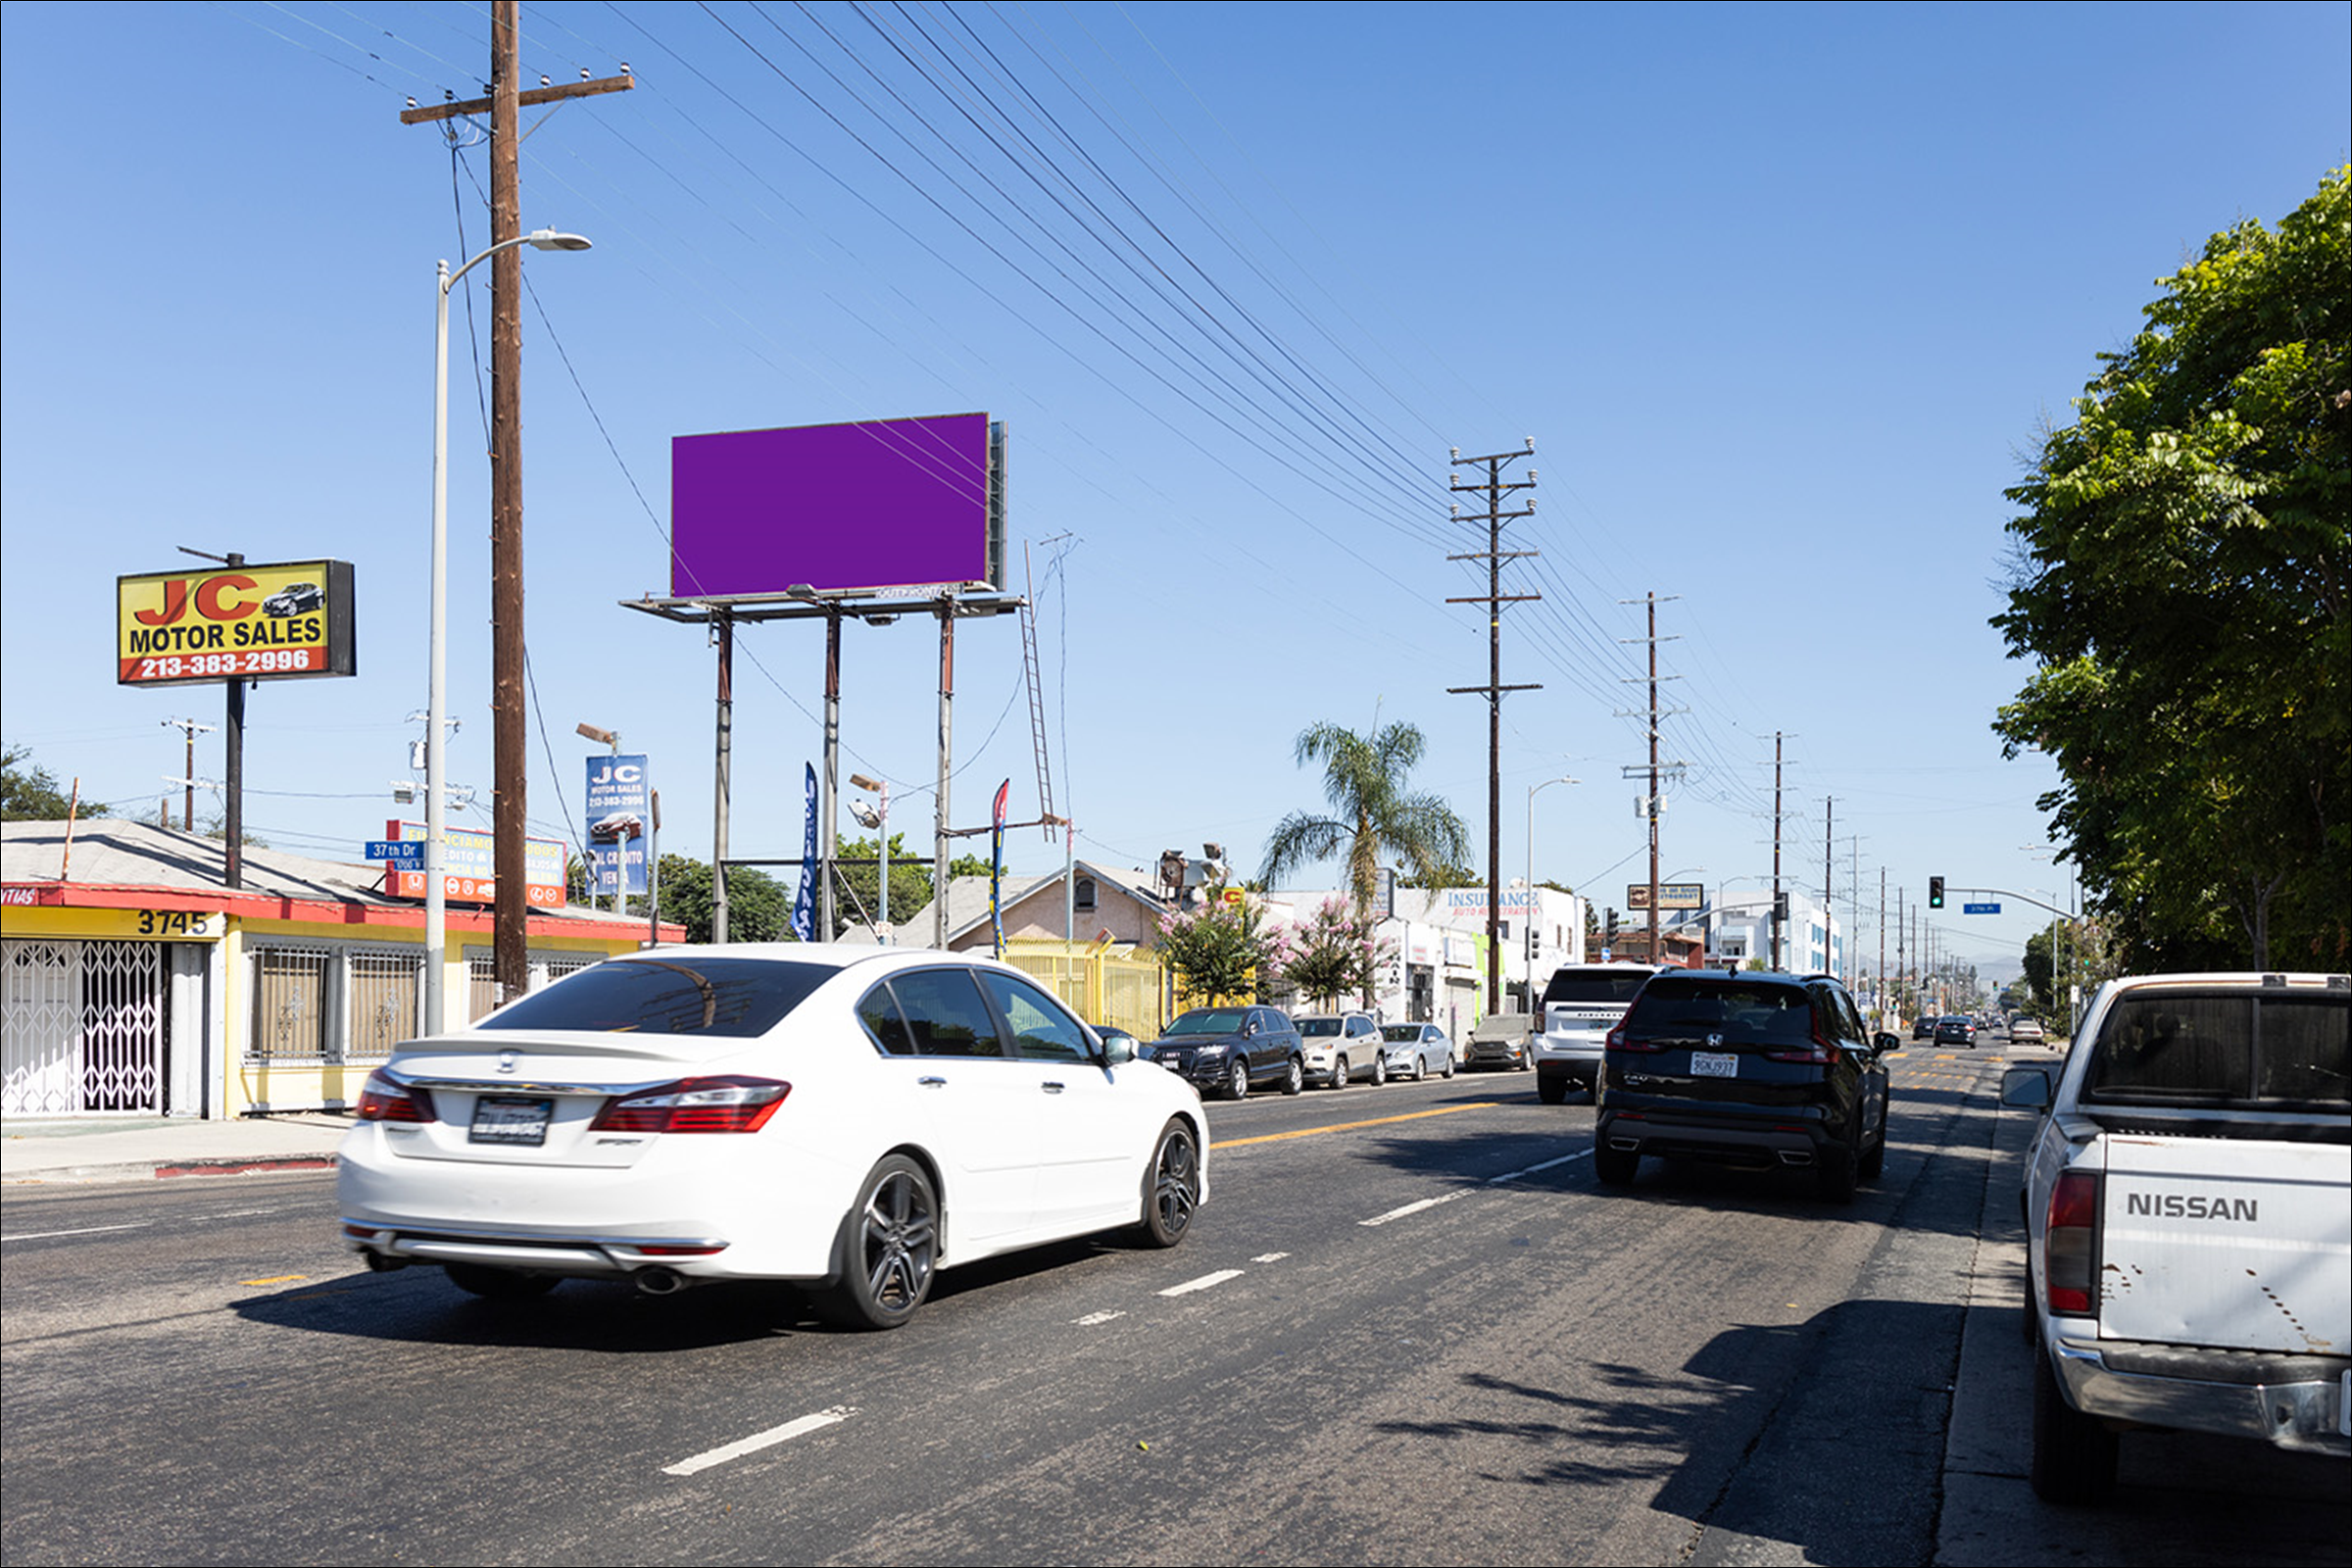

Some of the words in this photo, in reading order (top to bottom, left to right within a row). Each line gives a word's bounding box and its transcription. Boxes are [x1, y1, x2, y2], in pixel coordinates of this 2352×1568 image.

[133, 574, 260, 625] JC
[130, 623, 224, 654] MOTOR
[233, 617, 321, 647] SALES
[141, 650, 310, 678] 213-383-2996
[591, 764, 642, 784] JC
[617, 784, 642, 793] SALES
[372, 844, 400, 858] 37th
[403, 844, 416, 858] Dr
[524, 842, 559, 858] ODOS
[607, 850, 643, 864] CRDITO
[1447, 892, 1539, 907] INSUANCE
[137, 909, 208, 935] 3745
[2128, 1193, 2258, 1221] NISSAN
